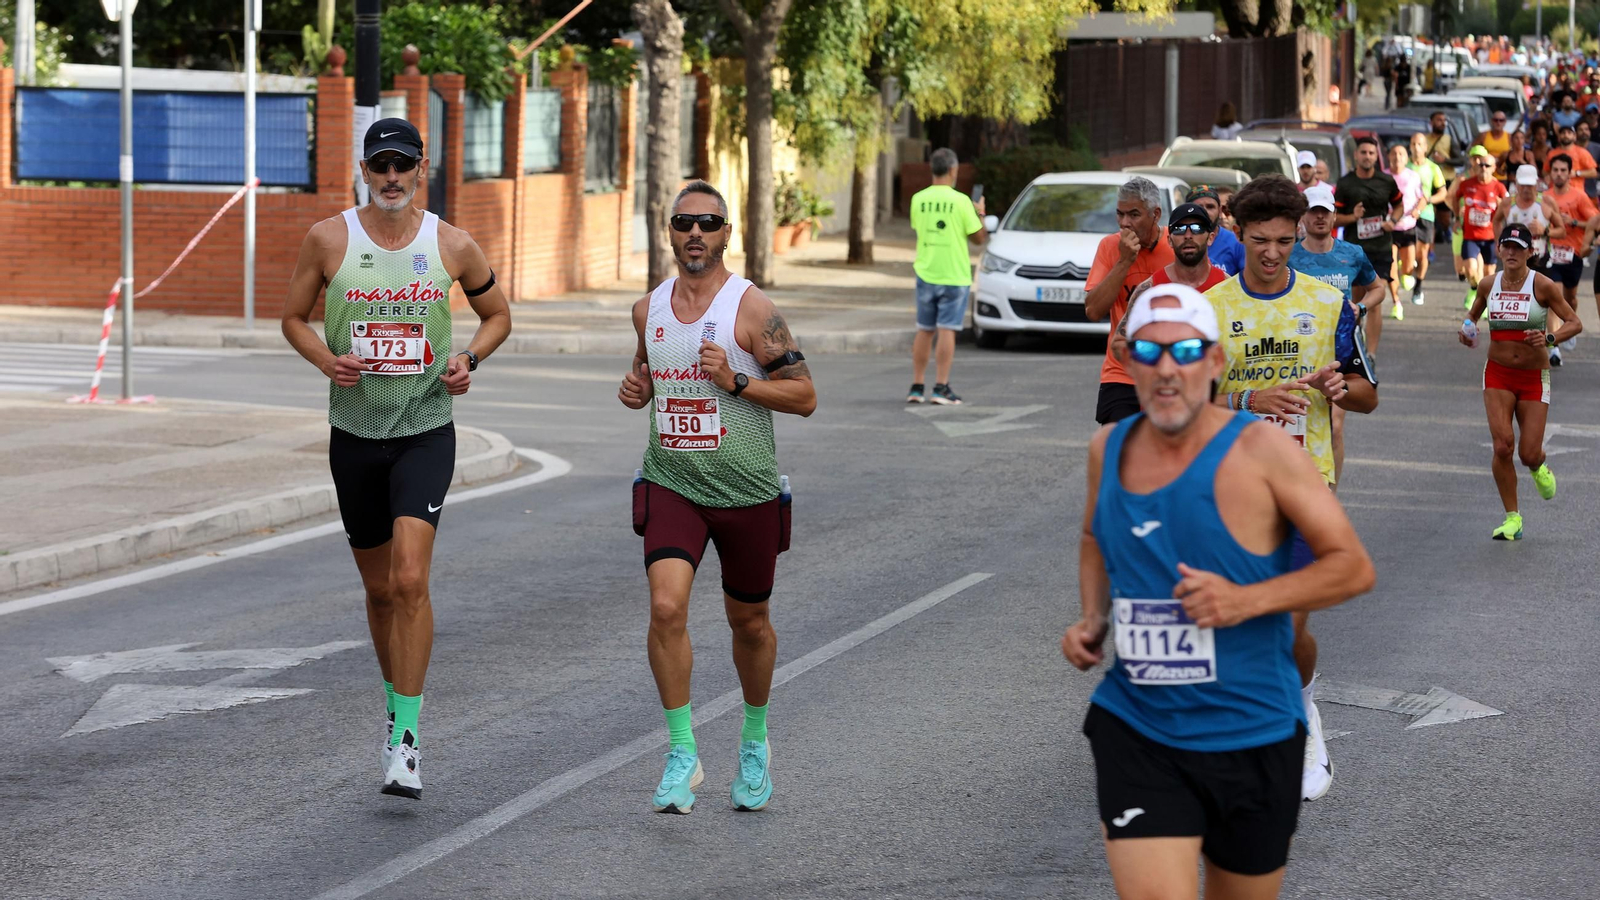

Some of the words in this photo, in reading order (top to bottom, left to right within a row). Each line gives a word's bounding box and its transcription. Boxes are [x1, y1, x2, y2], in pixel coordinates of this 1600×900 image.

[921, 201, 954, 213] STAFF
[345, 280, 444, 302] maratón
[1044, 288, 1071, 301] 9393
[366, 306, 428, 316] JEREZ
[1499, 301, 1520, 311] 148
[370, 340, 407, 357] 173
[1228, 366, 1275, 381] OLIMPO
[669, 415, 701, 433] 150
[1129, 629, 1194, 655] 1114
